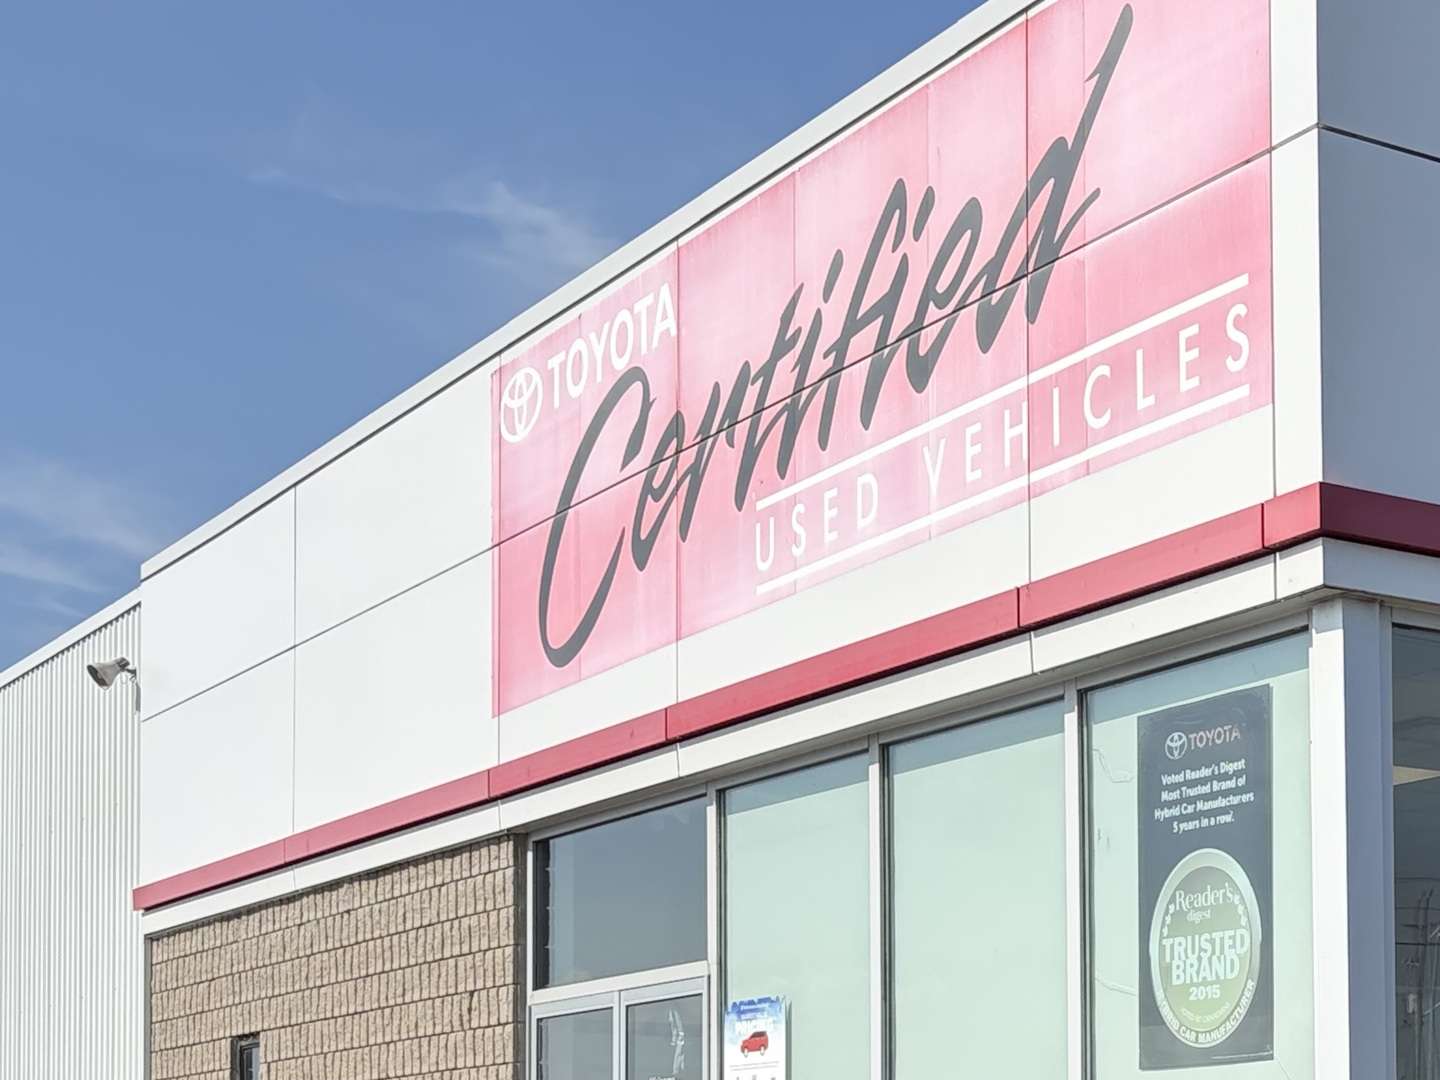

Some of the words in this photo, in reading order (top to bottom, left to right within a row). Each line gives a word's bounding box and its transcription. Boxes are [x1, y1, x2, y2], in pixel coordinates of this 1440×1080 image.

[538, 3, 1134, 668] Certified
[547, 283, 677, 410] TOYOTA
[754, 470, 879, 572] USED
[922, 302, 1252, 497] VEHICLES
[1189, 724, 1241, 750] TOYOTA
[1161, 770, 1184, 786] Voted
[1185, 764, 1219, 780] Reader's
[1220, 758, 1246, 774] Digest
[1161, 790, 1180, 802] Most
[1181, 781, 1210, 798] Trusted
[1213, 776, 1236, 792] Brand
[1237, 774, 1246, 786] of
[1154, 804, 1181, 821] Hybrid
[1181, 803, 1195, 815] Car
[1196, 792, 1255, 812] Manufacturers
[1172, 821, 1178, 833] 5
[1179, 818, 1200, 834] years
[1201, 815, 1209, 827] in
[1210, 817, 1216, 826] a
[1175, 882, 1233, 911] Reader's
[1186, 908, 1211, 924] digest
[1162, 928, 1249, 964] TRUSTED
[1171, 952, 1240, 985] BRAND
[1189, 985, 1221, 1001] 2015
[1180, 1026, 1197, 1042] CAR
